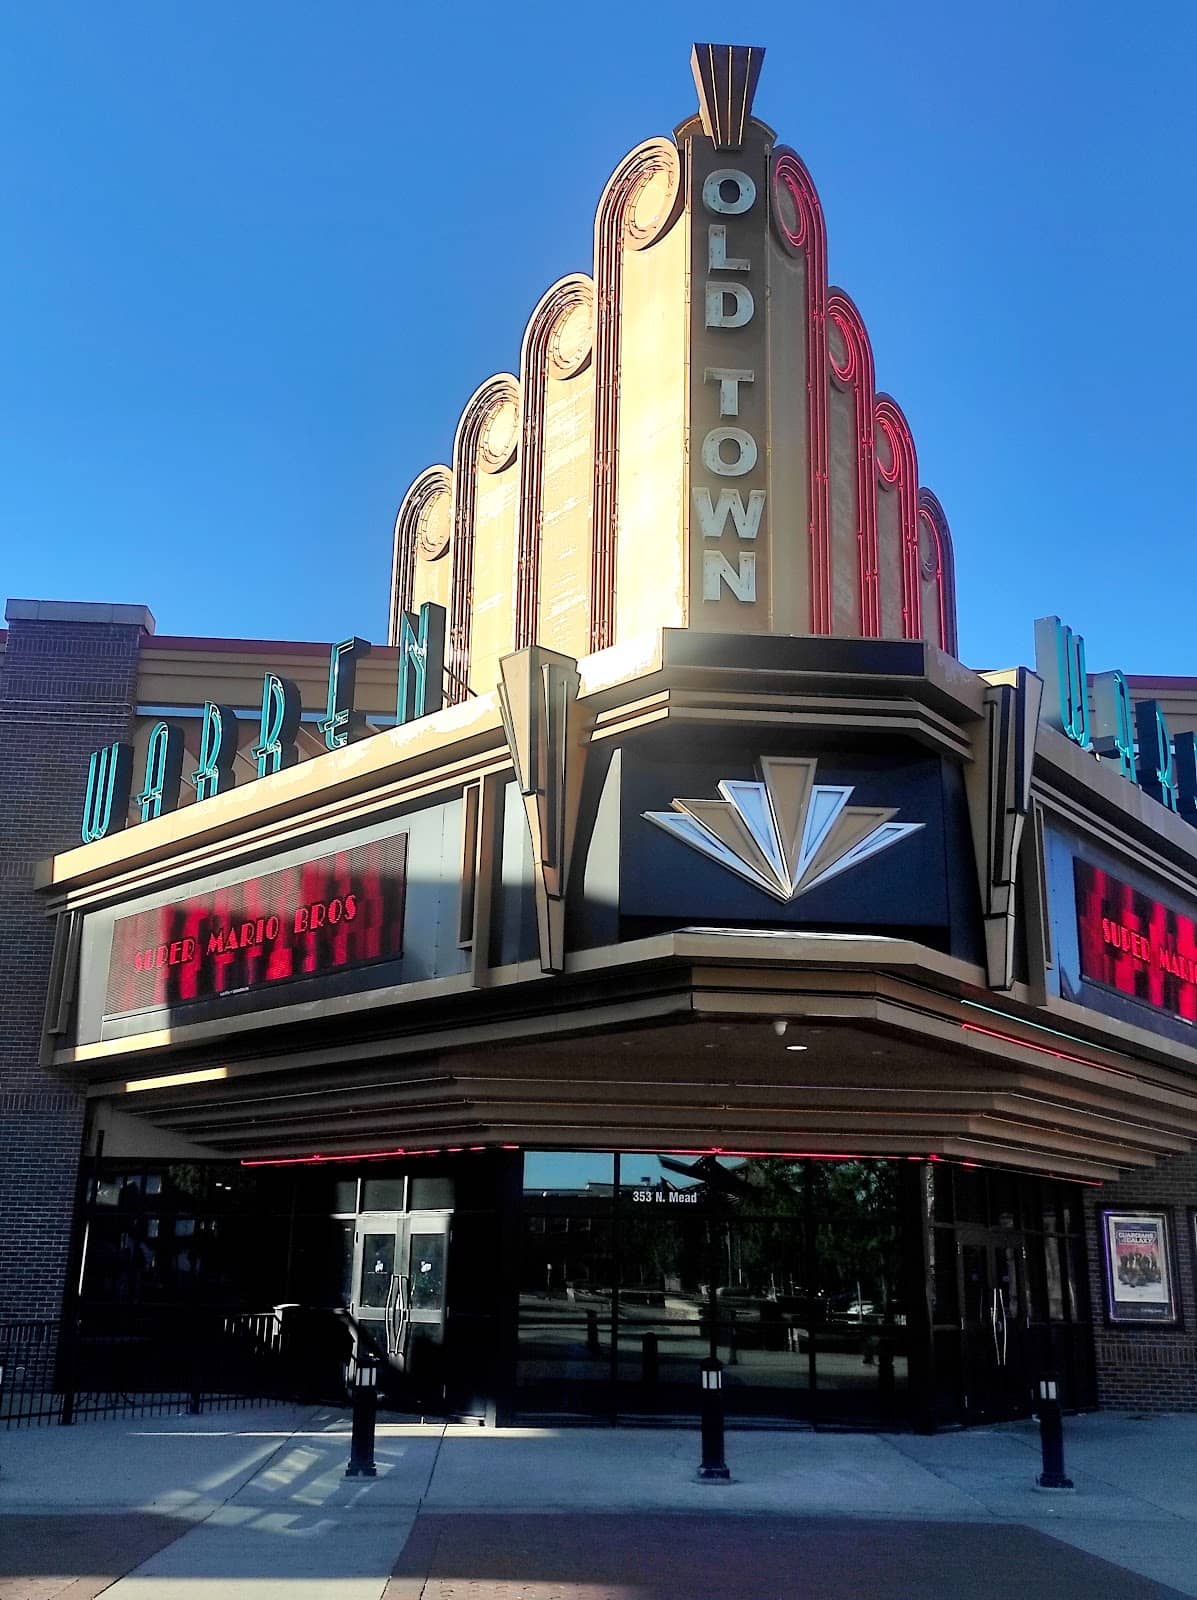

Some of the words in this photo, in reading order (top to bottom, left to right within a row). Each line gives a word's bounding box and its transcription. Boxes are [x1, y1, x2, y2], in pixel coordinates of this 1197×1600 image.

[701, 168, 758, 330] OLD
[691, 366, 767, 604] TOWN
[81, 602, 446, 844] WARREN
[1034, 615, 1197, 828] WAR
[134, 937, 196, 972] SUPER
[206, 915, 280, 956] MARIO
[293, 894, 358, 935] BROS
[1102, 917, 1151, 962] SUPER
[632, 1190, 653, 1202] 353
[655, 1191, 666, 1203] N.
[668, 1191, 697, 1203] Mead
